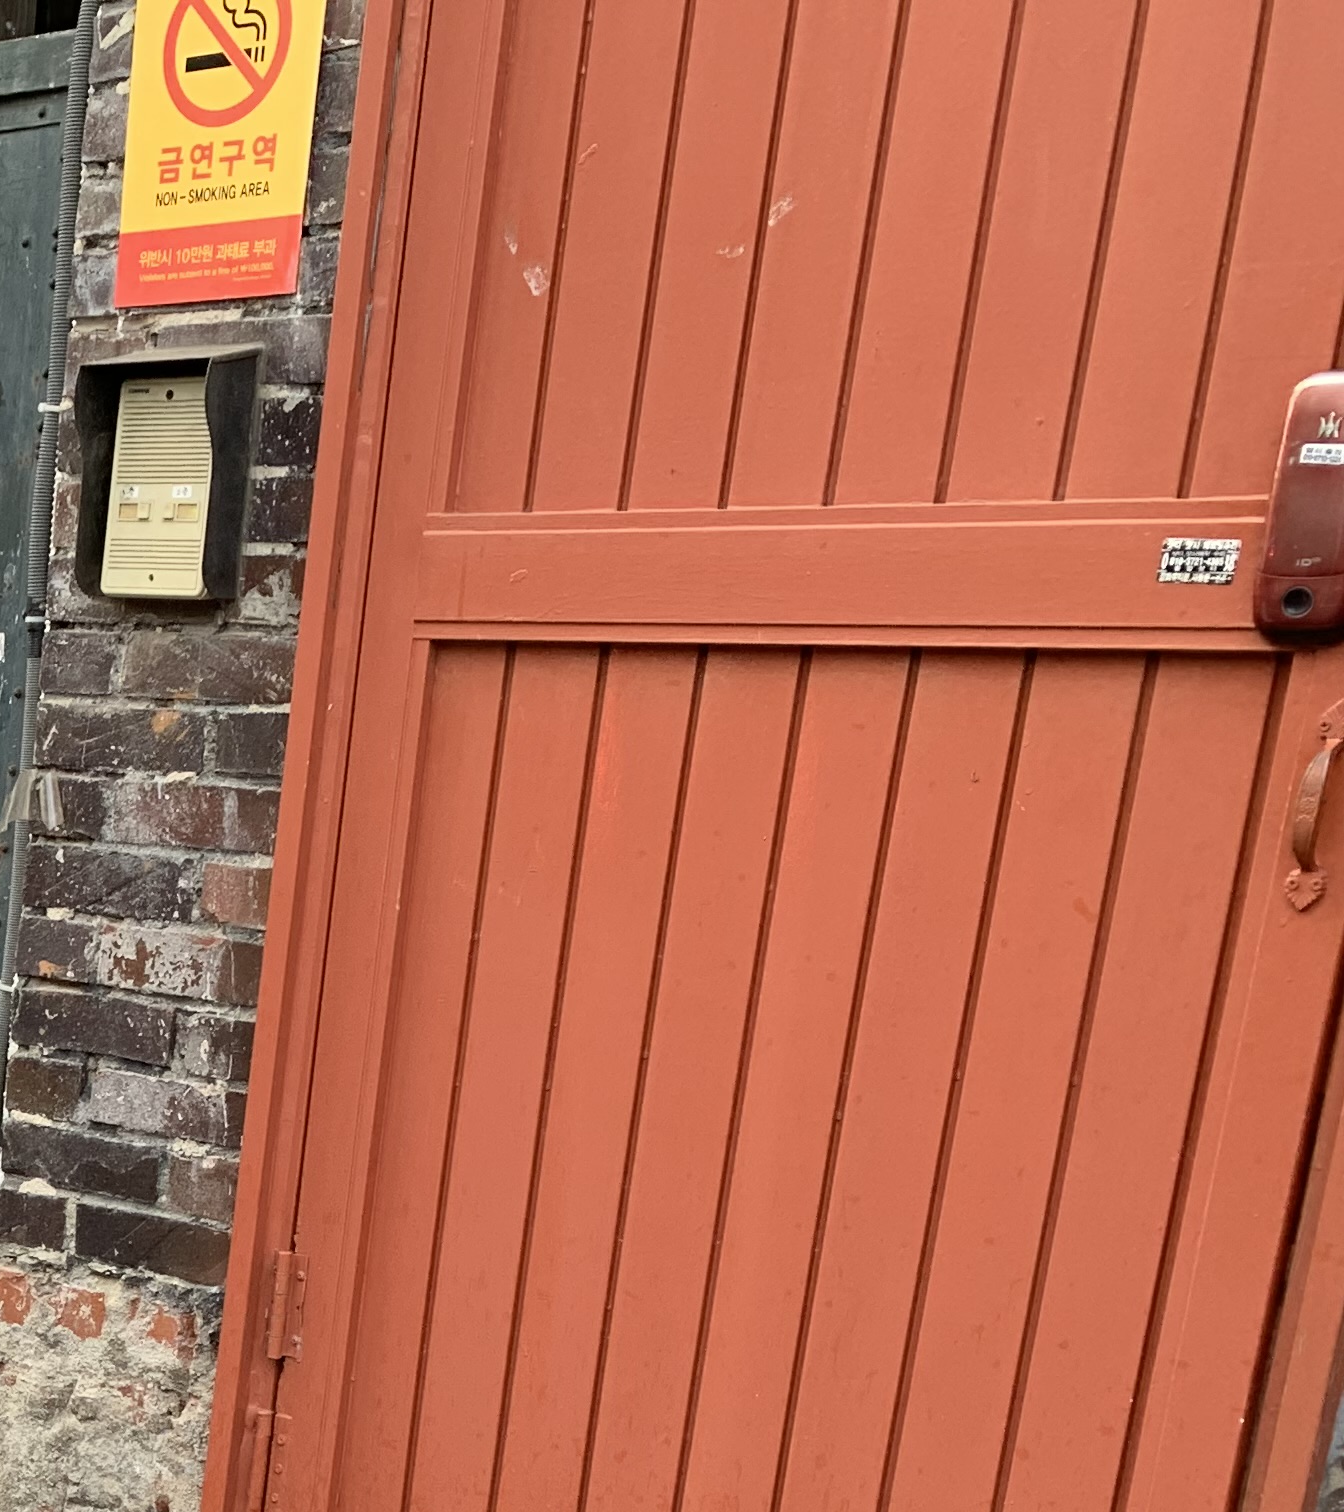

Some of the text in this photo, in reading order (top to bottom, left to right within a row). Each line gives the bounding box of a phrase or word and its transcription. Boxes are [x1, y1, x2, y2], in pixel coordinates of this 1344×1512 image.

[158, 133, 278, 184] 금연구역
[240, 181, 270, 198] AREA
[139, 238, 277, 268] 위반시 10만원 과태료 부과
